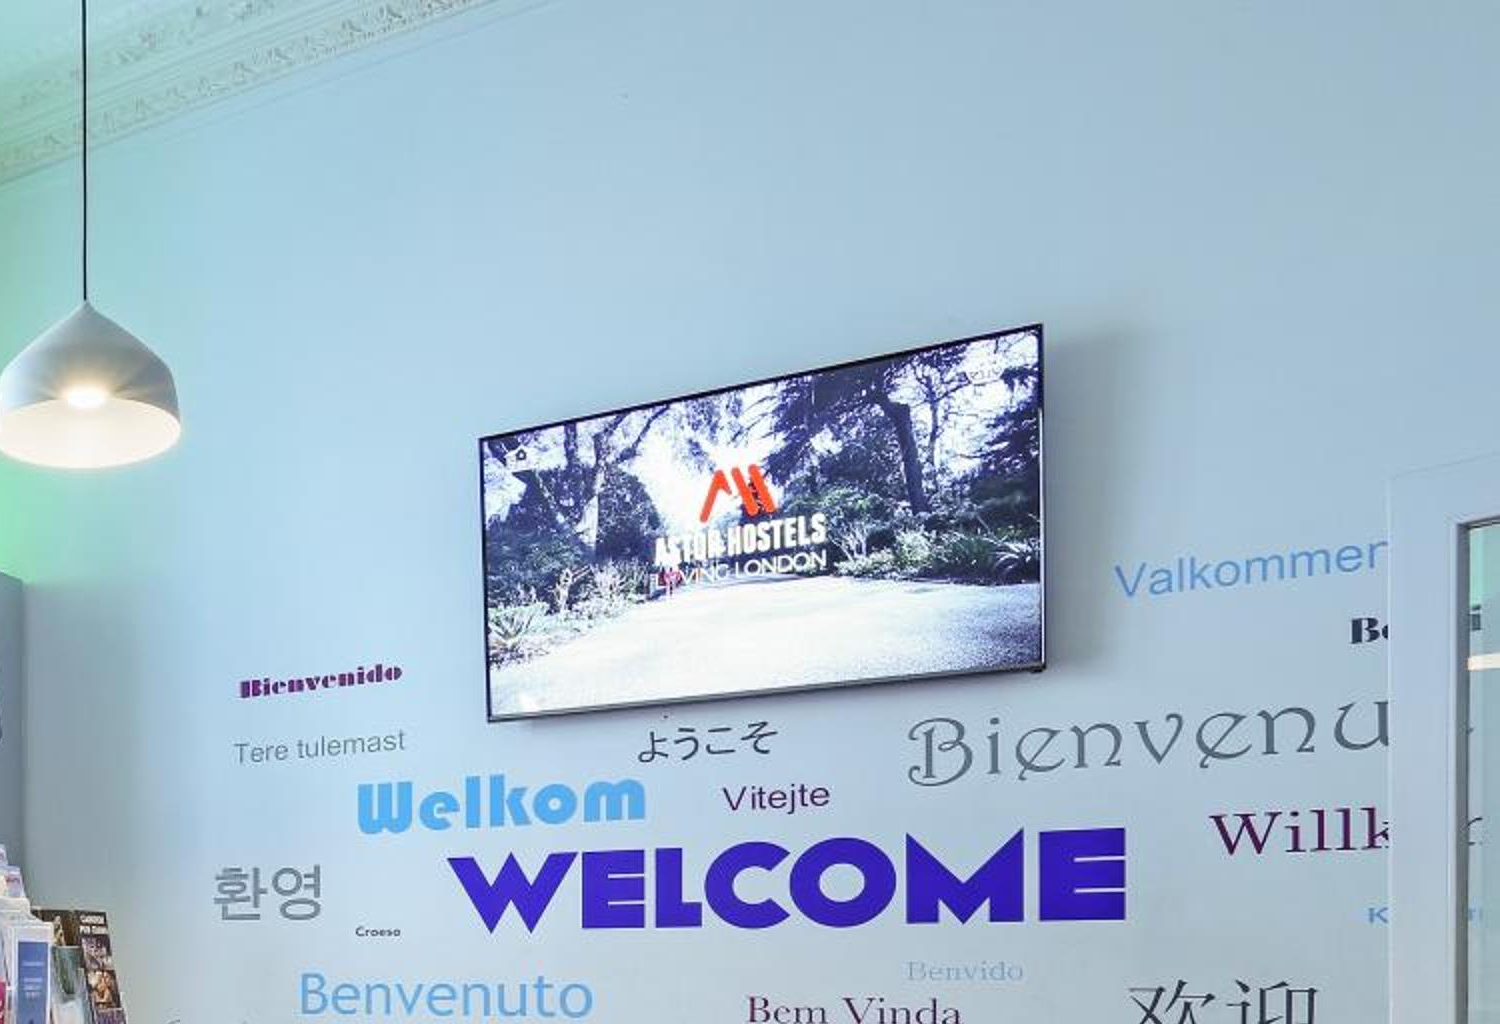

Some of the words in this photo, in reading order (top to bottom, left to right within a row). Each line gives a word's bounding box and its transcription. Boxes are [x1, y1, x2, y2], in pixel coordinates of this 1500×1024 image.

[654, 530, 725, 568] ASTOR
[728, 512, 827, 556] HOSTELS
[734, 549, 827, 577] LONDON
[240, 664, 402, 699] Bienvenido
[234, 743, 289, 764] Tere
[297, 729, 405, 759] tulemast
[638, 721, 778, 763] ようこそ
[357, 774, 646, 835] Welkom
[722, 783, 830, 815] Vitejte
[213, 864, 322, 921] 환영
[447, 827, 1127, 934] WELCOME
[355, 925, 401, 937] Croeso
[907, 959, 1025, 981] Benvido
[300, 972, 594, 1019] Benvenuto
[747, 996, 829, 1024] Bem
